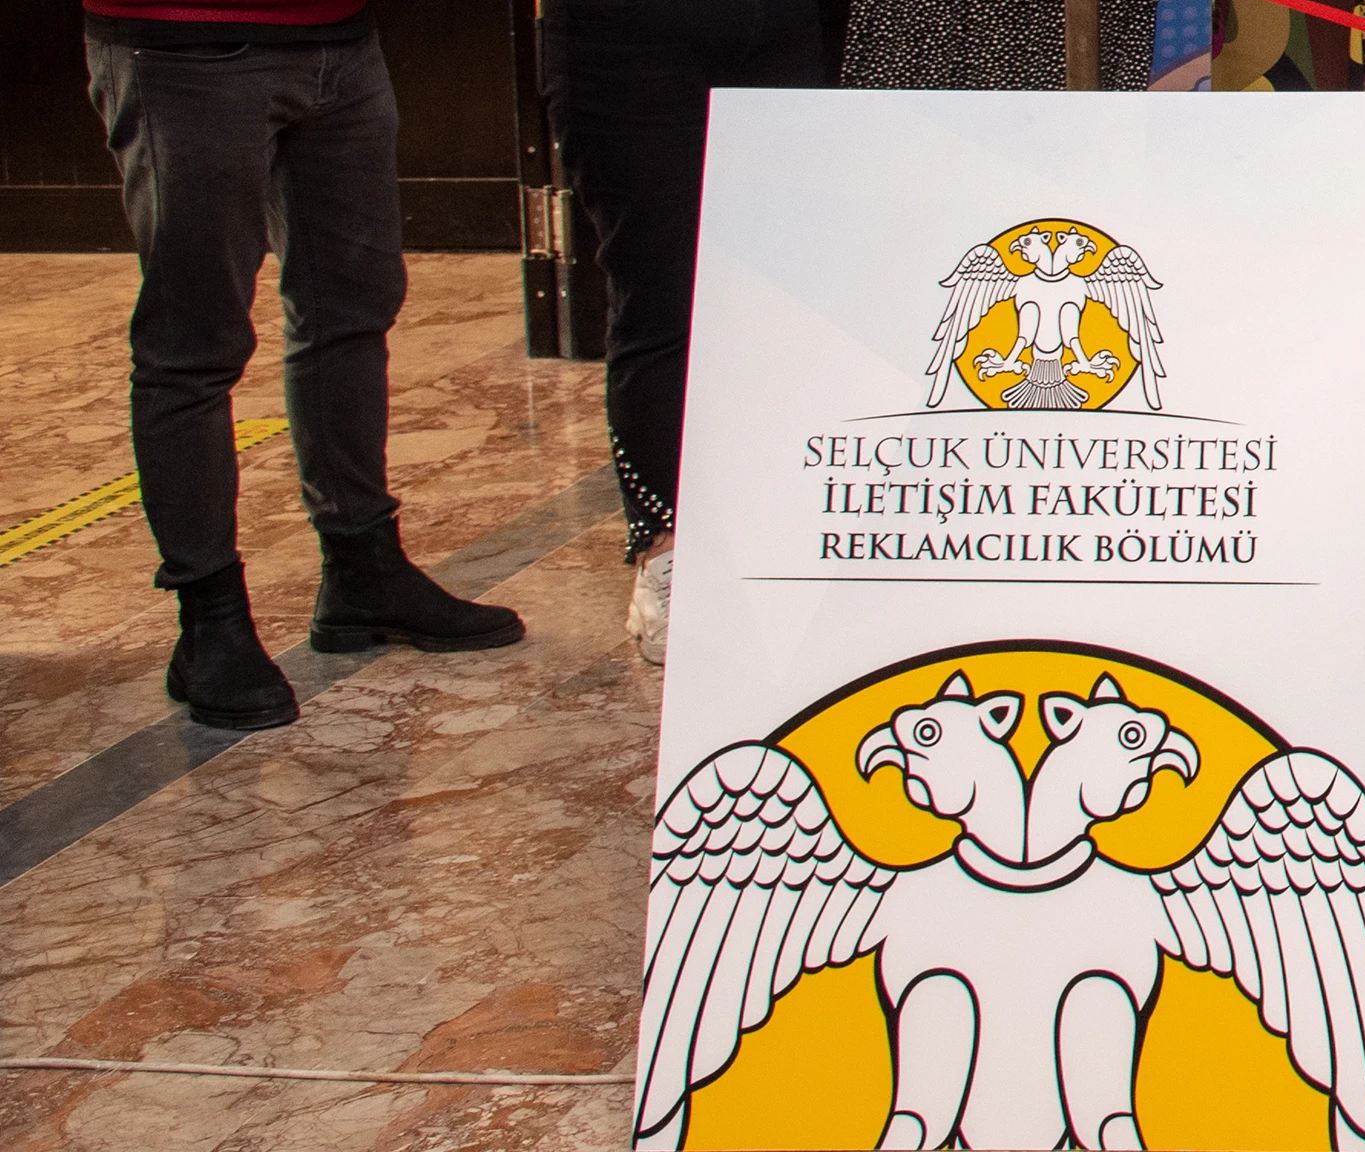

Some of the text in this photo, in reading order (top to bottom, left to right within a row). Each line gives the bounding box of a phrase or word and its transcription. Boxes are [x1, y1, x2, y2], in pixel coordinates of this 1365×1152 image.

[802, 431, 1278, 476] SELÇUK ÜNİVERSİTESİ
[821, 476, 1258, 525] İLETİŞİM FAKÜLTESİ
[820, 529, 1259, 565] REKLAMCILIK BÖLÜMÜ
